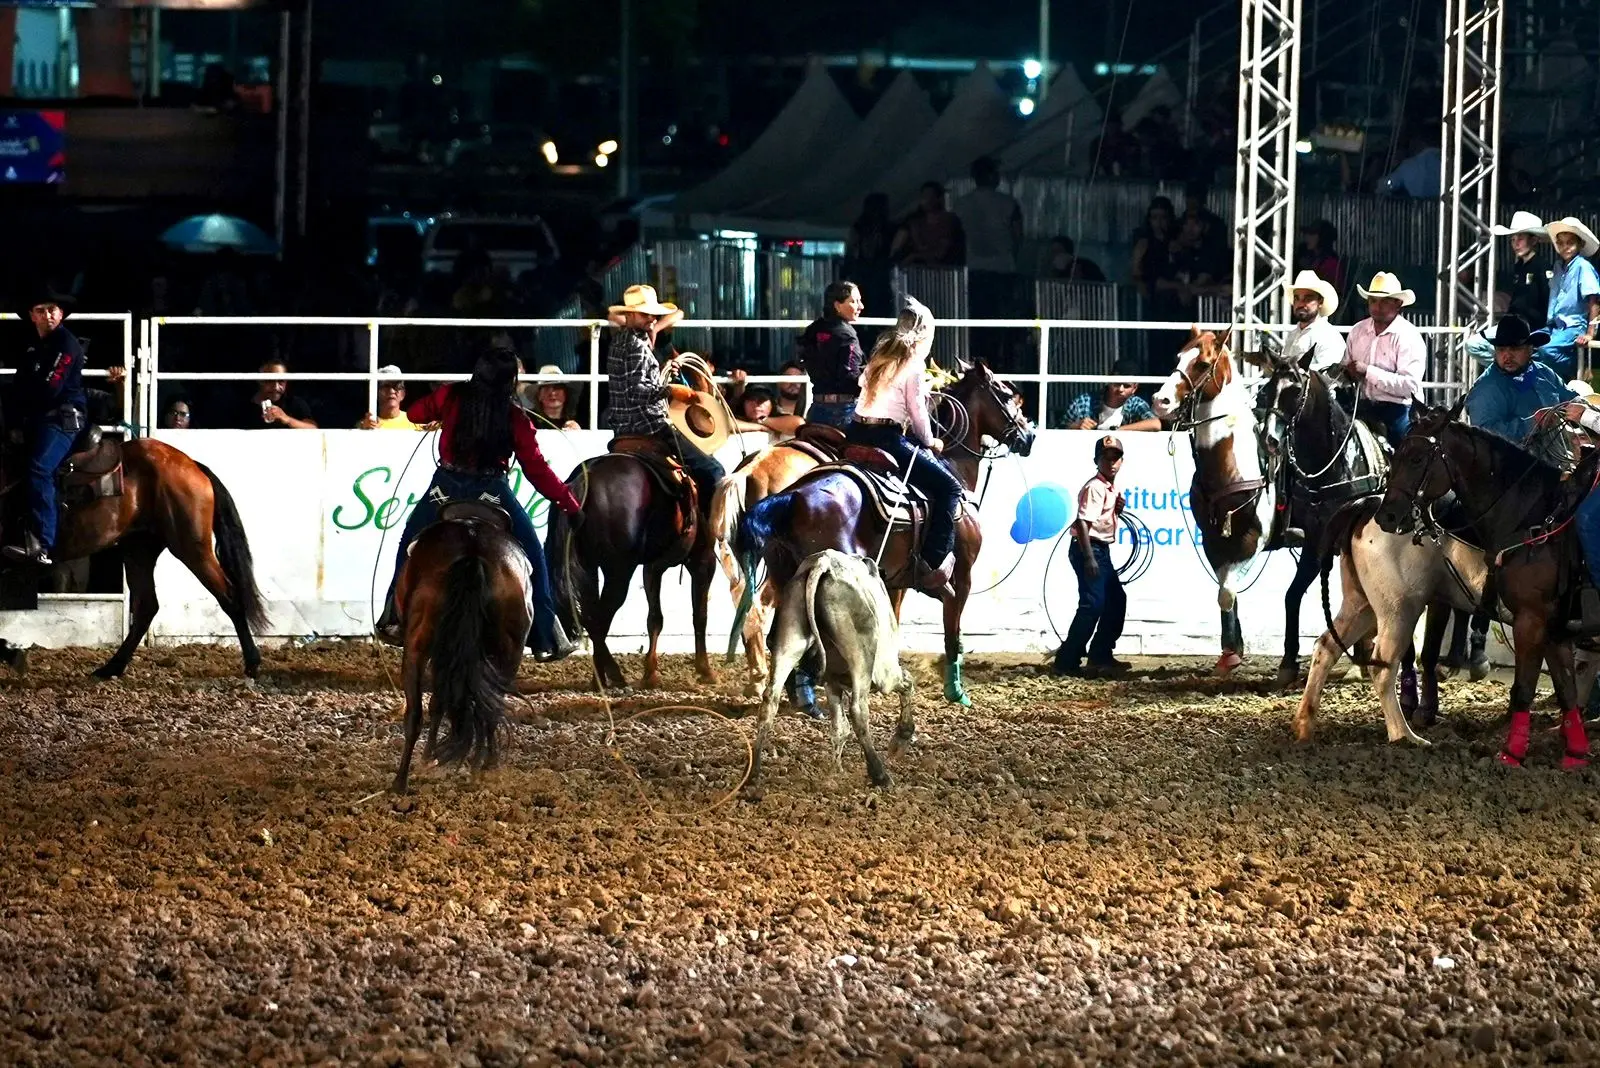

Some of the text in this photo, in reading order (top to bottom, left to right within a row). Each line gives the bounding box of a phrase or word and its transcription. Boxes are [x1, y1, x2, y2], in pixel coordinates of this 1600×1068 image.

[332, 466, 421, 530] Ser
[1124, 486, 1192, 511] tituto
[1118, 527, 1184, 546] nsar
